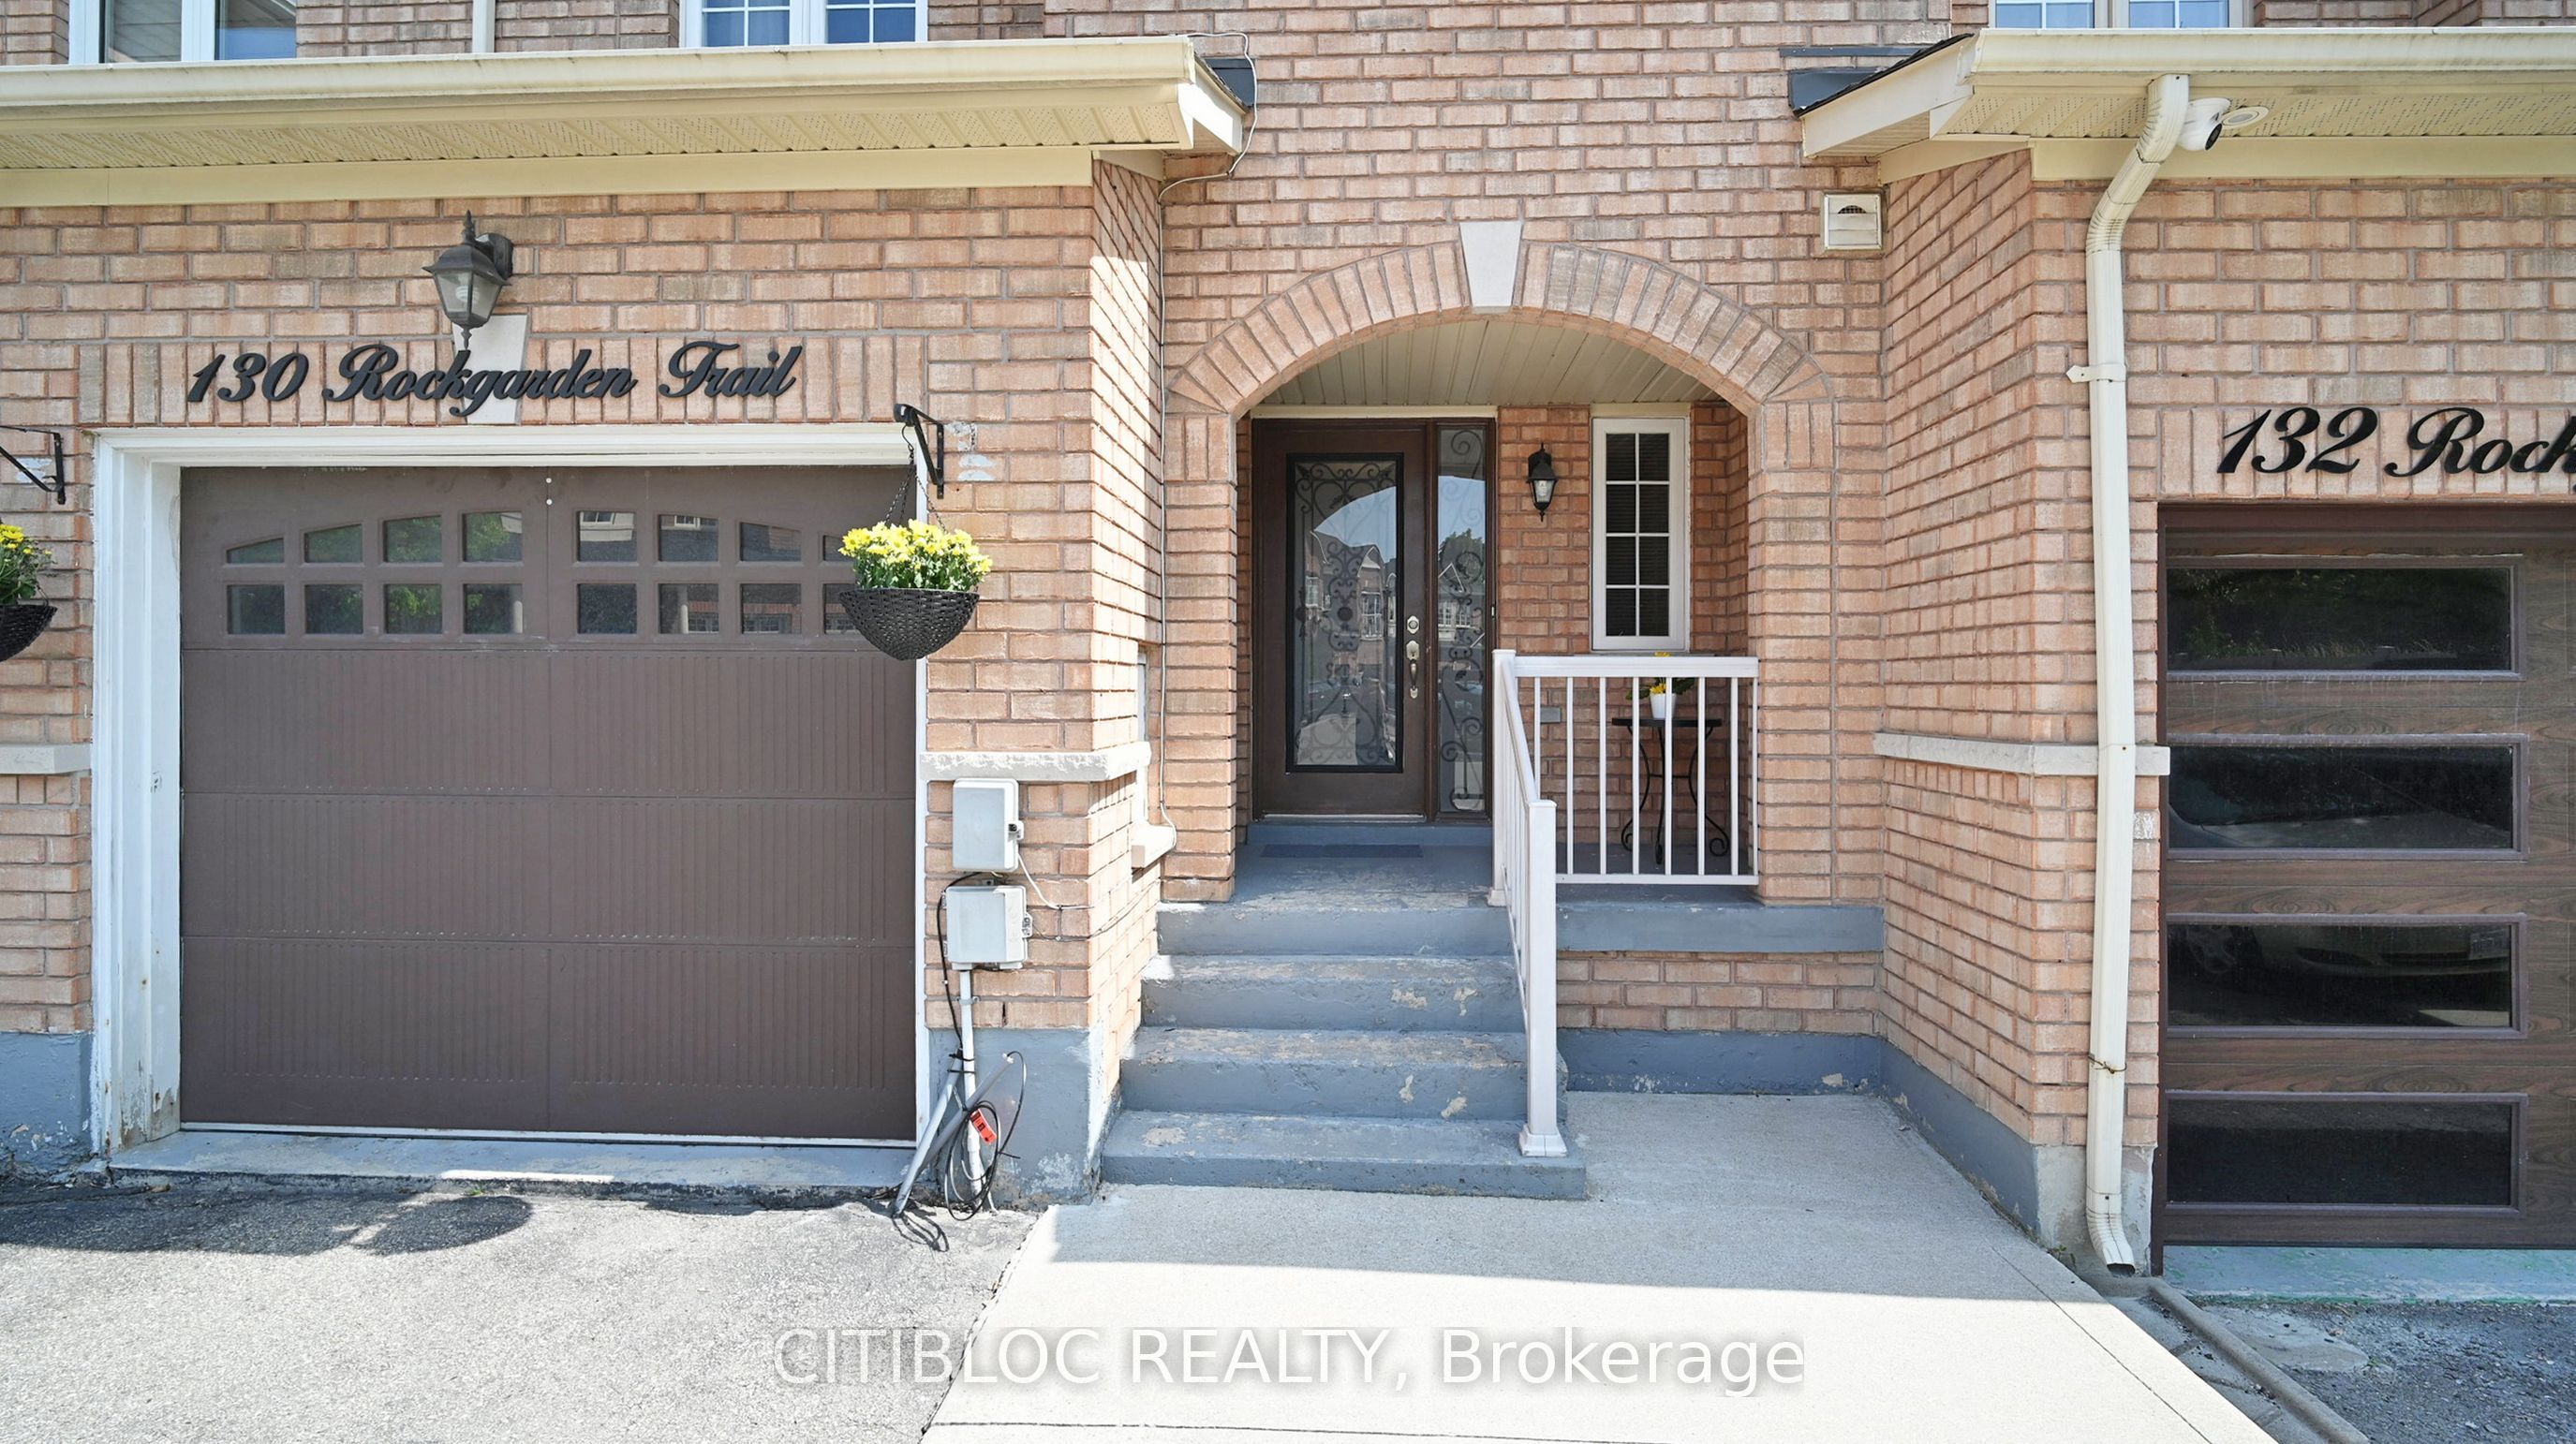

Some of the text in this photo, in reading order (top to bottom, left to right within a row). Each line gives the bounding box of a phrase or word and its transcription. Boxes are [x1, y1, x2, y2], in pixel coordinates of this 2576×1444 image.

[186, 340, 803, 416] 130 Rockgarden Trail
[2216, 406, 2378, 475] 132
